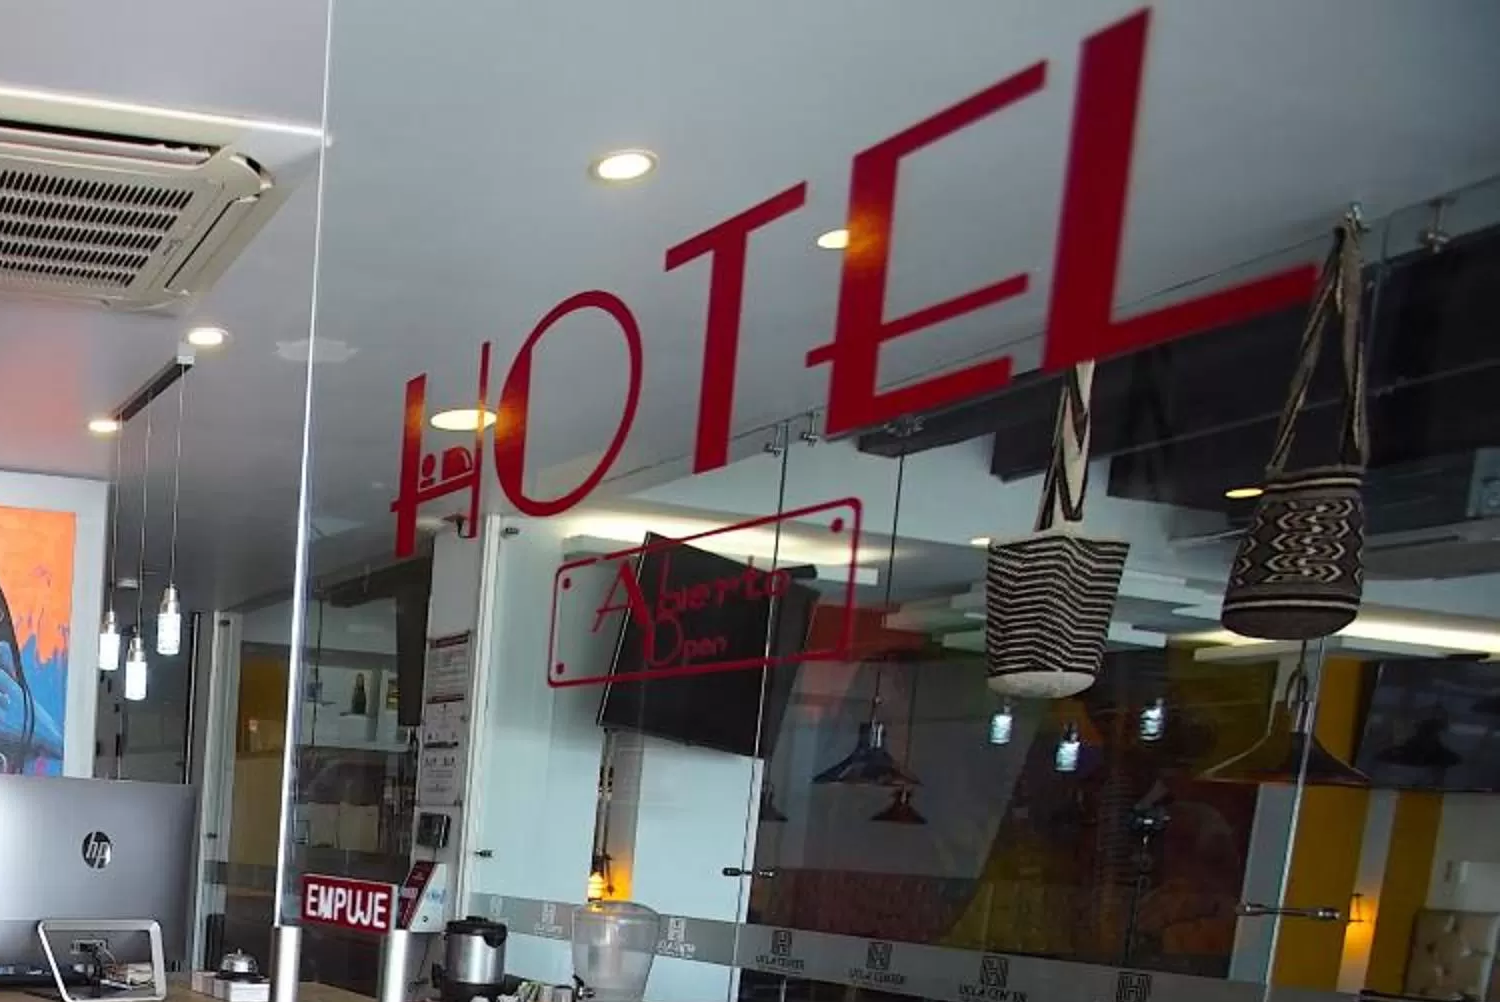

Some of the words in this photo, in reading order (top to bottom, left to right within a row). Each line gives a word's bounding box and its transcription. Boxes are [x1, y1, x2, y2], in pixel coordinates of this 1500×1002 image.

[391, 6, 1318, 558] HOTEL
[592, 552, 792, 662] Abierto
[649, 613, 728, 668] Open
[85, 831, 111, 869] hp
[305, 883, 389, 929] EMPUJE
